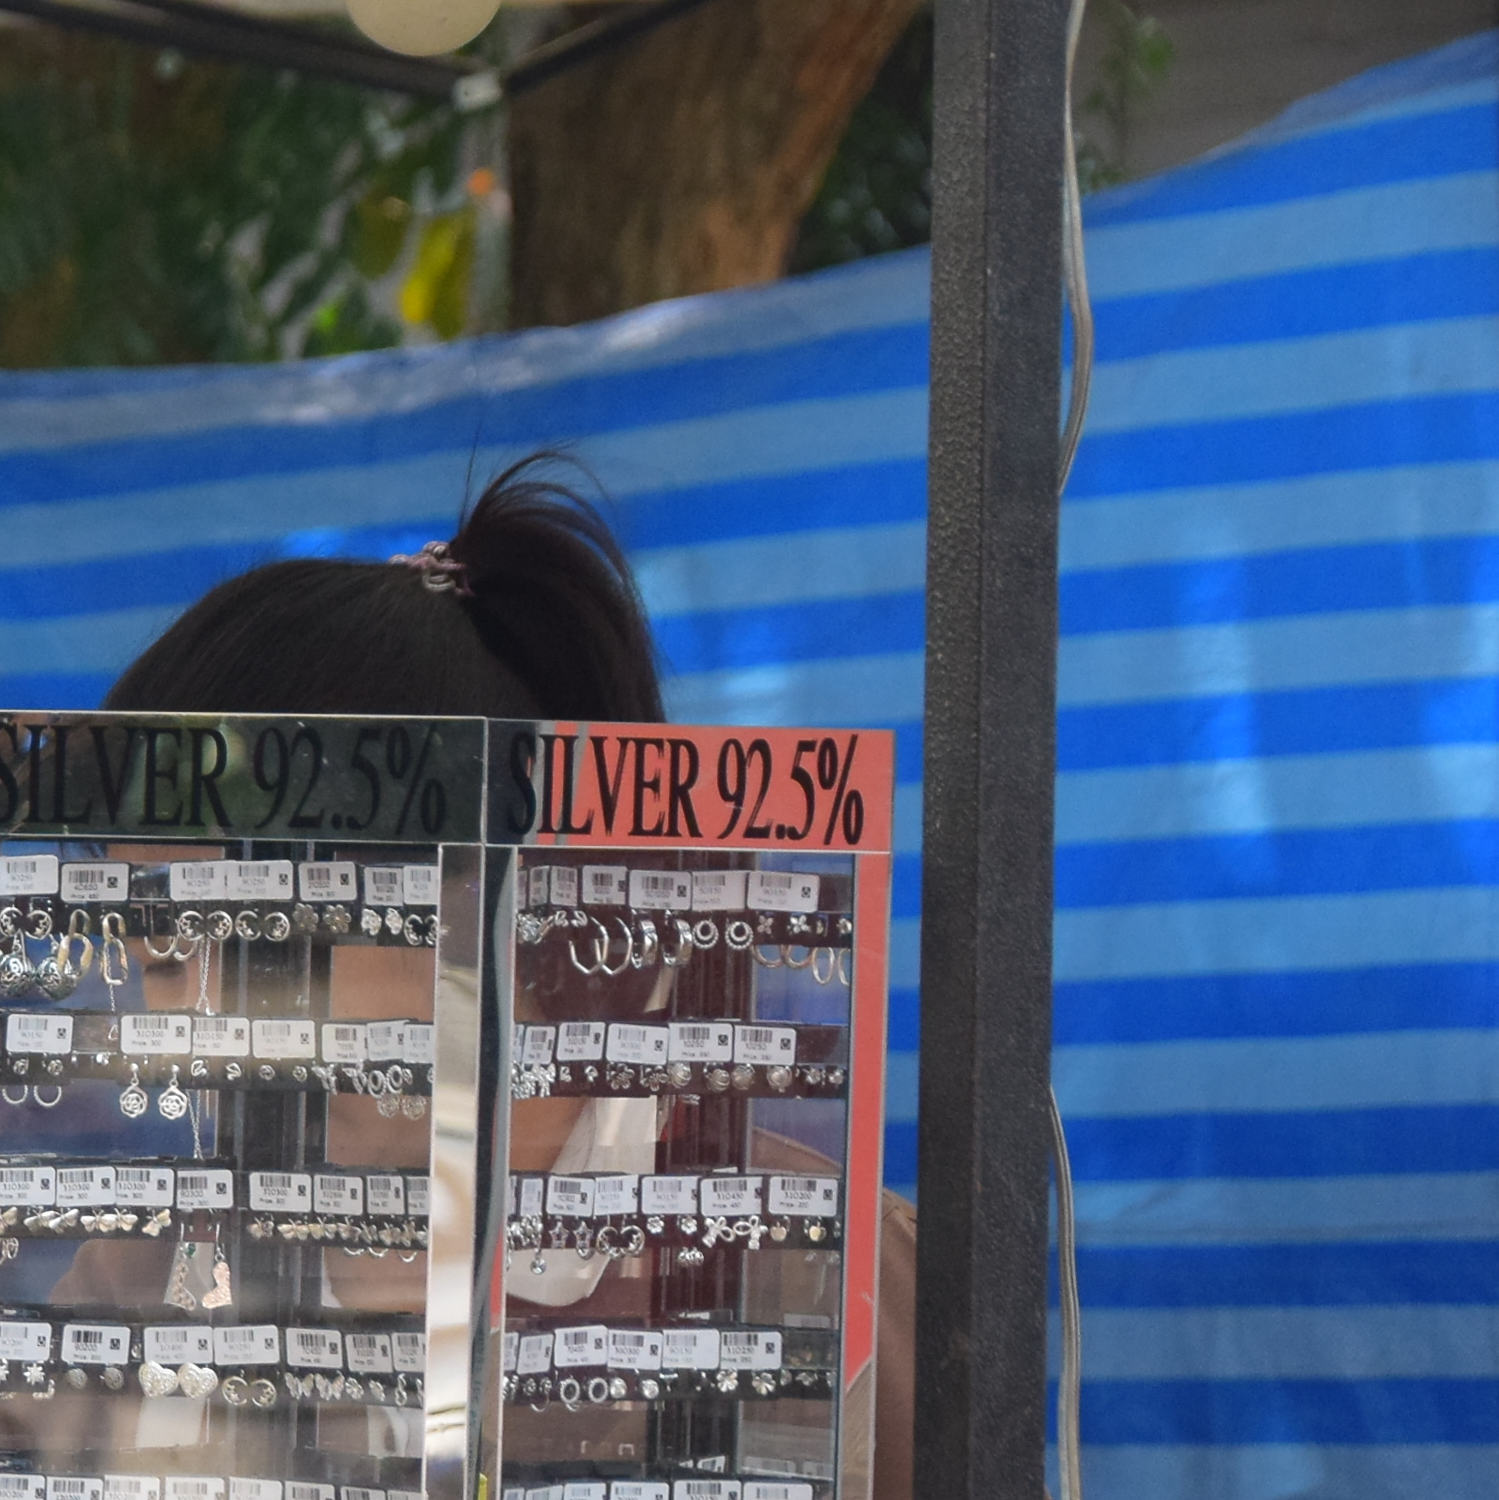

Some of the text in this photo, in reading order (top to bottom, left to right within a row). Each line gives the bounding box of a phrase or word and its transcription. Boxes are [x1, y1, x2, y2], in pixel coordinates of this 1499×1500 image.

[253, 724, 448, 834] 92.5%
[506, 730, 866, 845] SILVER 92.5%
